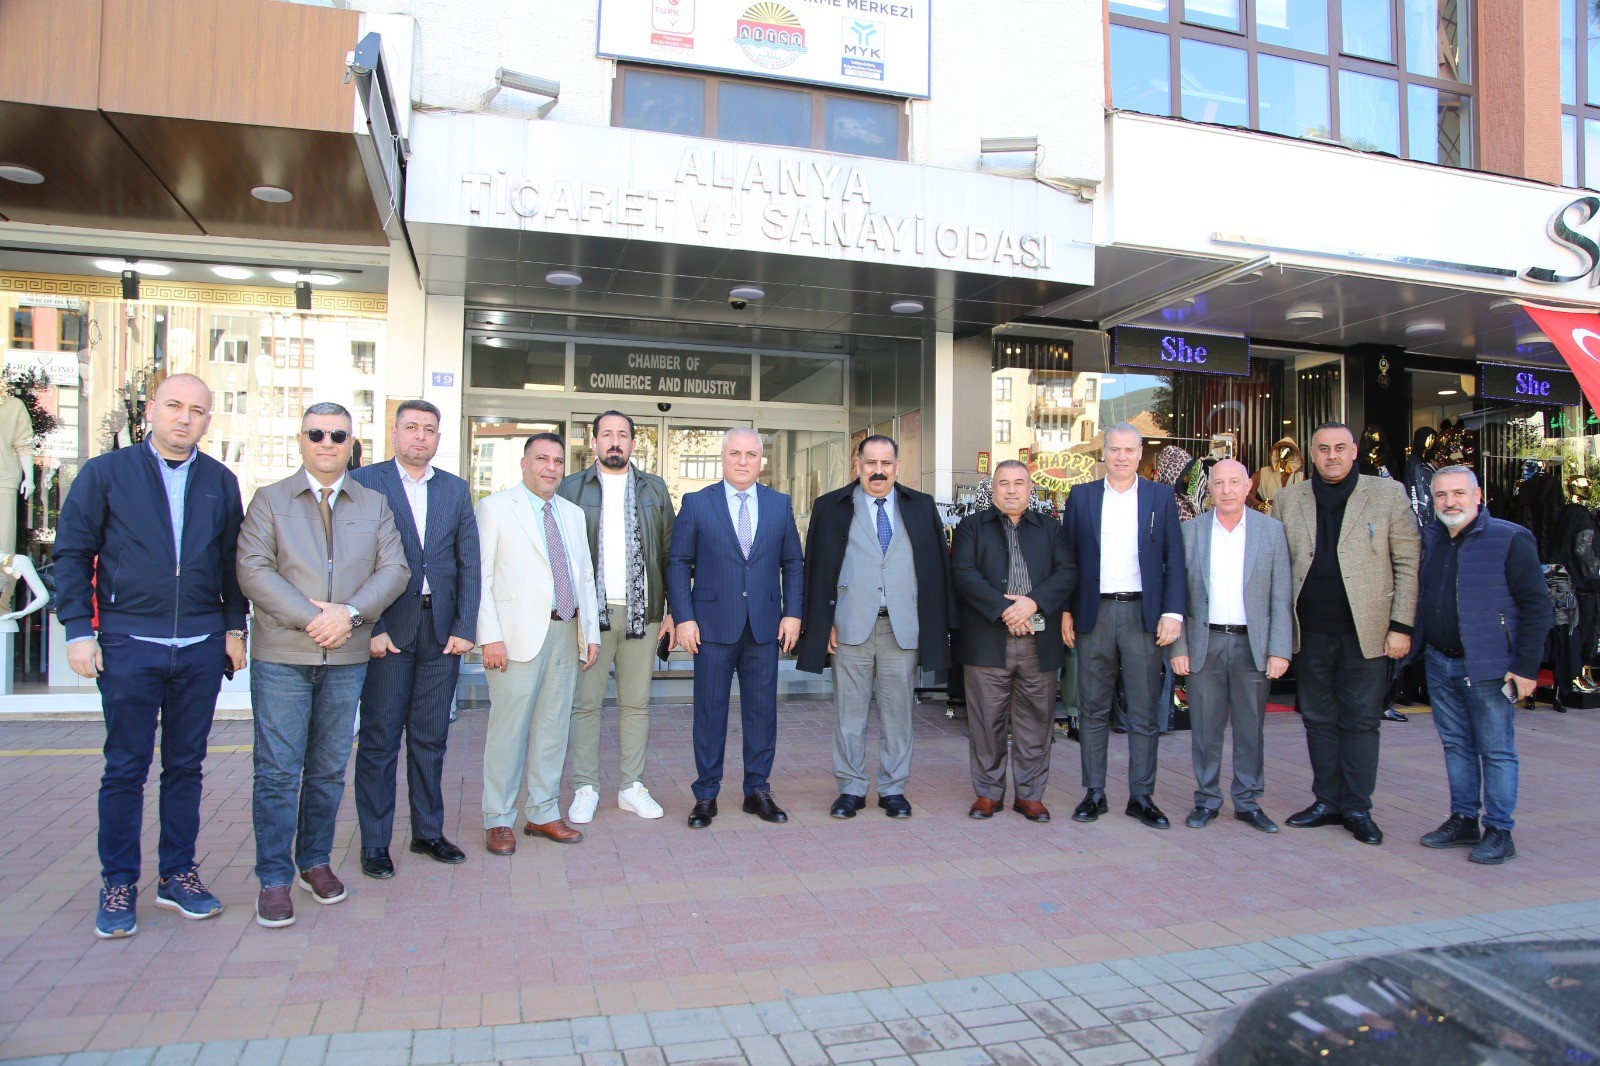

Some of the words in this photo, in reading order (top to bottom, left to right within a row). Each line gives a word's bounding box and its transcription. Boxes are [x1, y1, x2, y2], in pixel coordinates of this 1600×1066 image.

[847, 0, 913, 19] MERKEZİ
[741, 28, 802, 46] ALTSO
[844, 44, 881, 59] MYK
[675, 147, 871, 204] ALANYA
[462, 168, 675, 229] TİCARET
[762, 202, 926, 255] SANAYİ
[935, 222, 1054, 269] ODASI
[1518, 196, 1600, 288] S
[1161, 336, 1208, 364] She
[628, 352, 680, 370] CHAMBER
[686, 356, 701, 371] OF
[434, 375, 453, 384] 19
[590, 372, 652, 390] COMMERCE
[658, 376, 681, 392] AND
[684, 378, 736, 395] INDUSTRY
[1515, 372, 1551, 396] She
[1037, 453, 1095, 471] HAPPY
[1031, 470, 1061, 490] NEW
